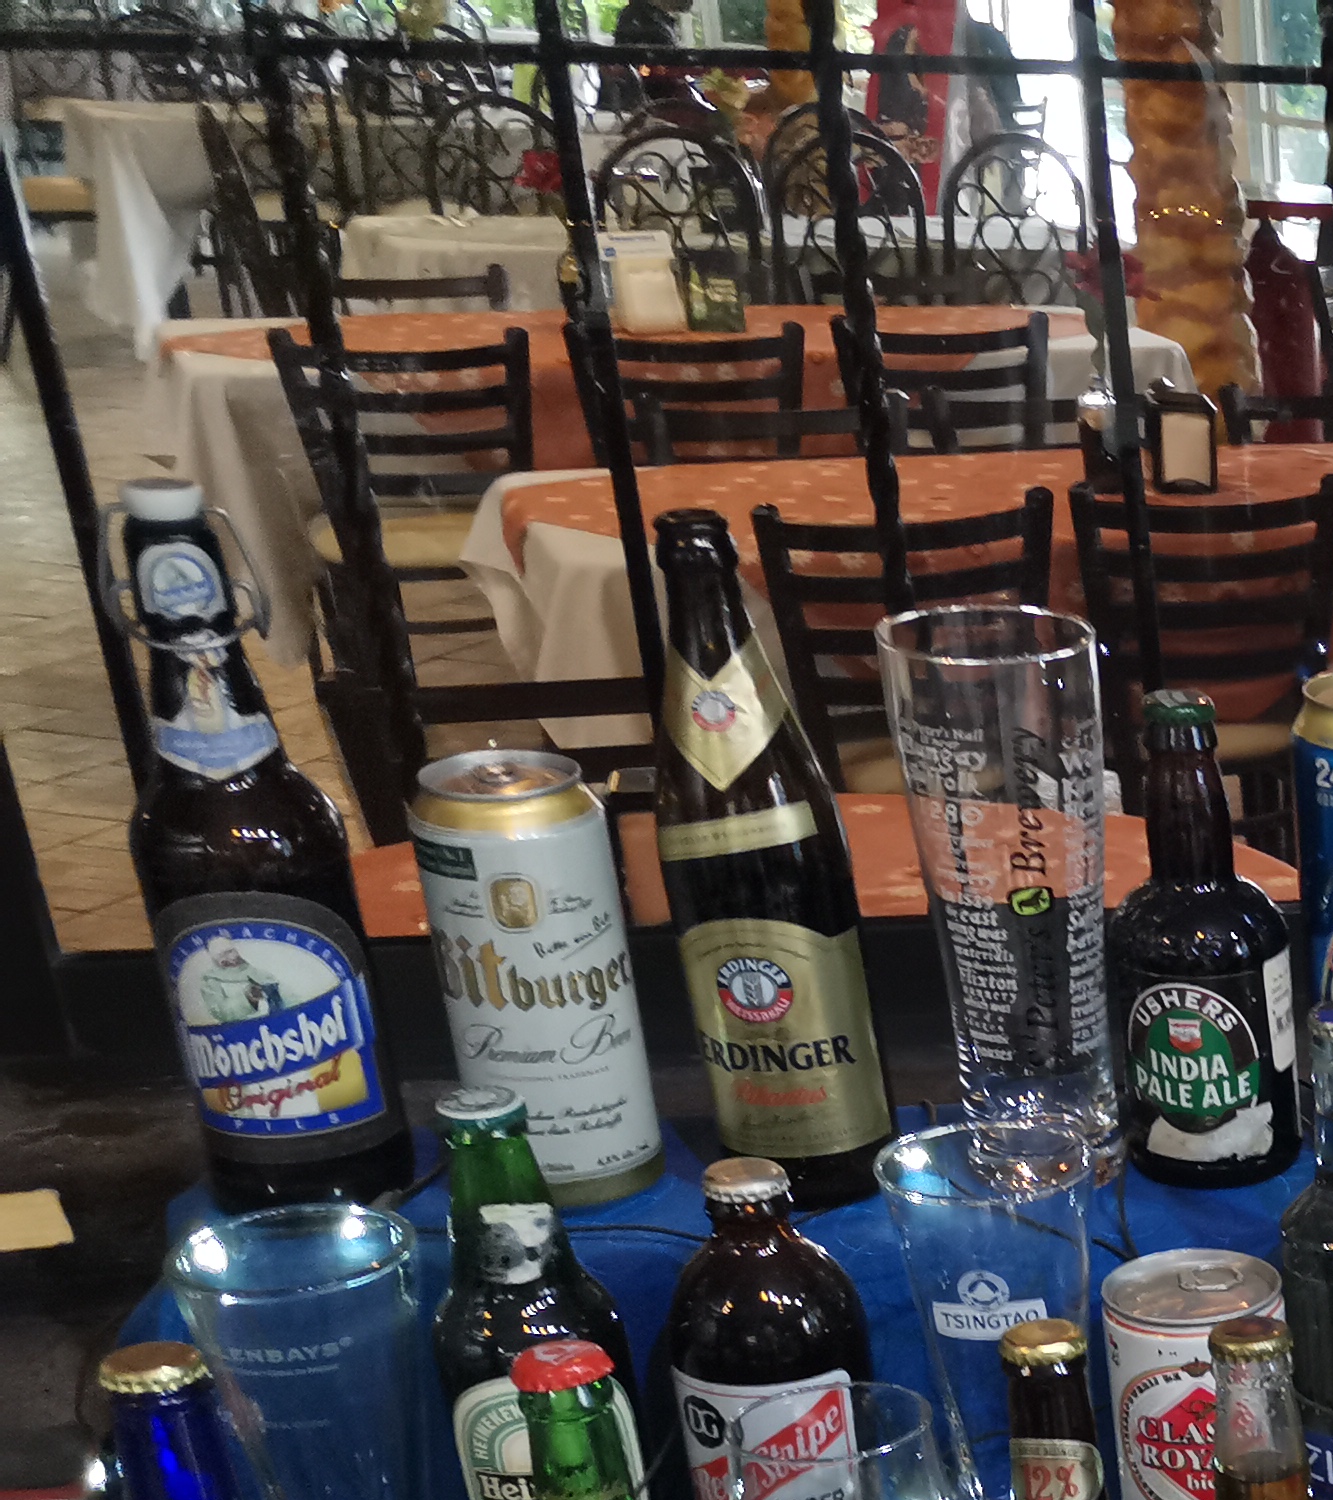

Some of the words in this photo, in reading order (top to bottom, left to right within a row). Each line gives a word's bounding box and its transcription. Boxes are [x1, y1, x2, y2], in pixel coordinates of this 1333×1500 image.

[1133, 989, 1239, 1034] USHERS
[702, 1034, 857, 1074] ERDINGER
[1149, 1051, 1230, 1080] INDIA
[1135, 1070, 1194, 1108] PALE
[1200, 1070, 1253, 1109] ALE
[233, 1111, 341, 1132] PILS
